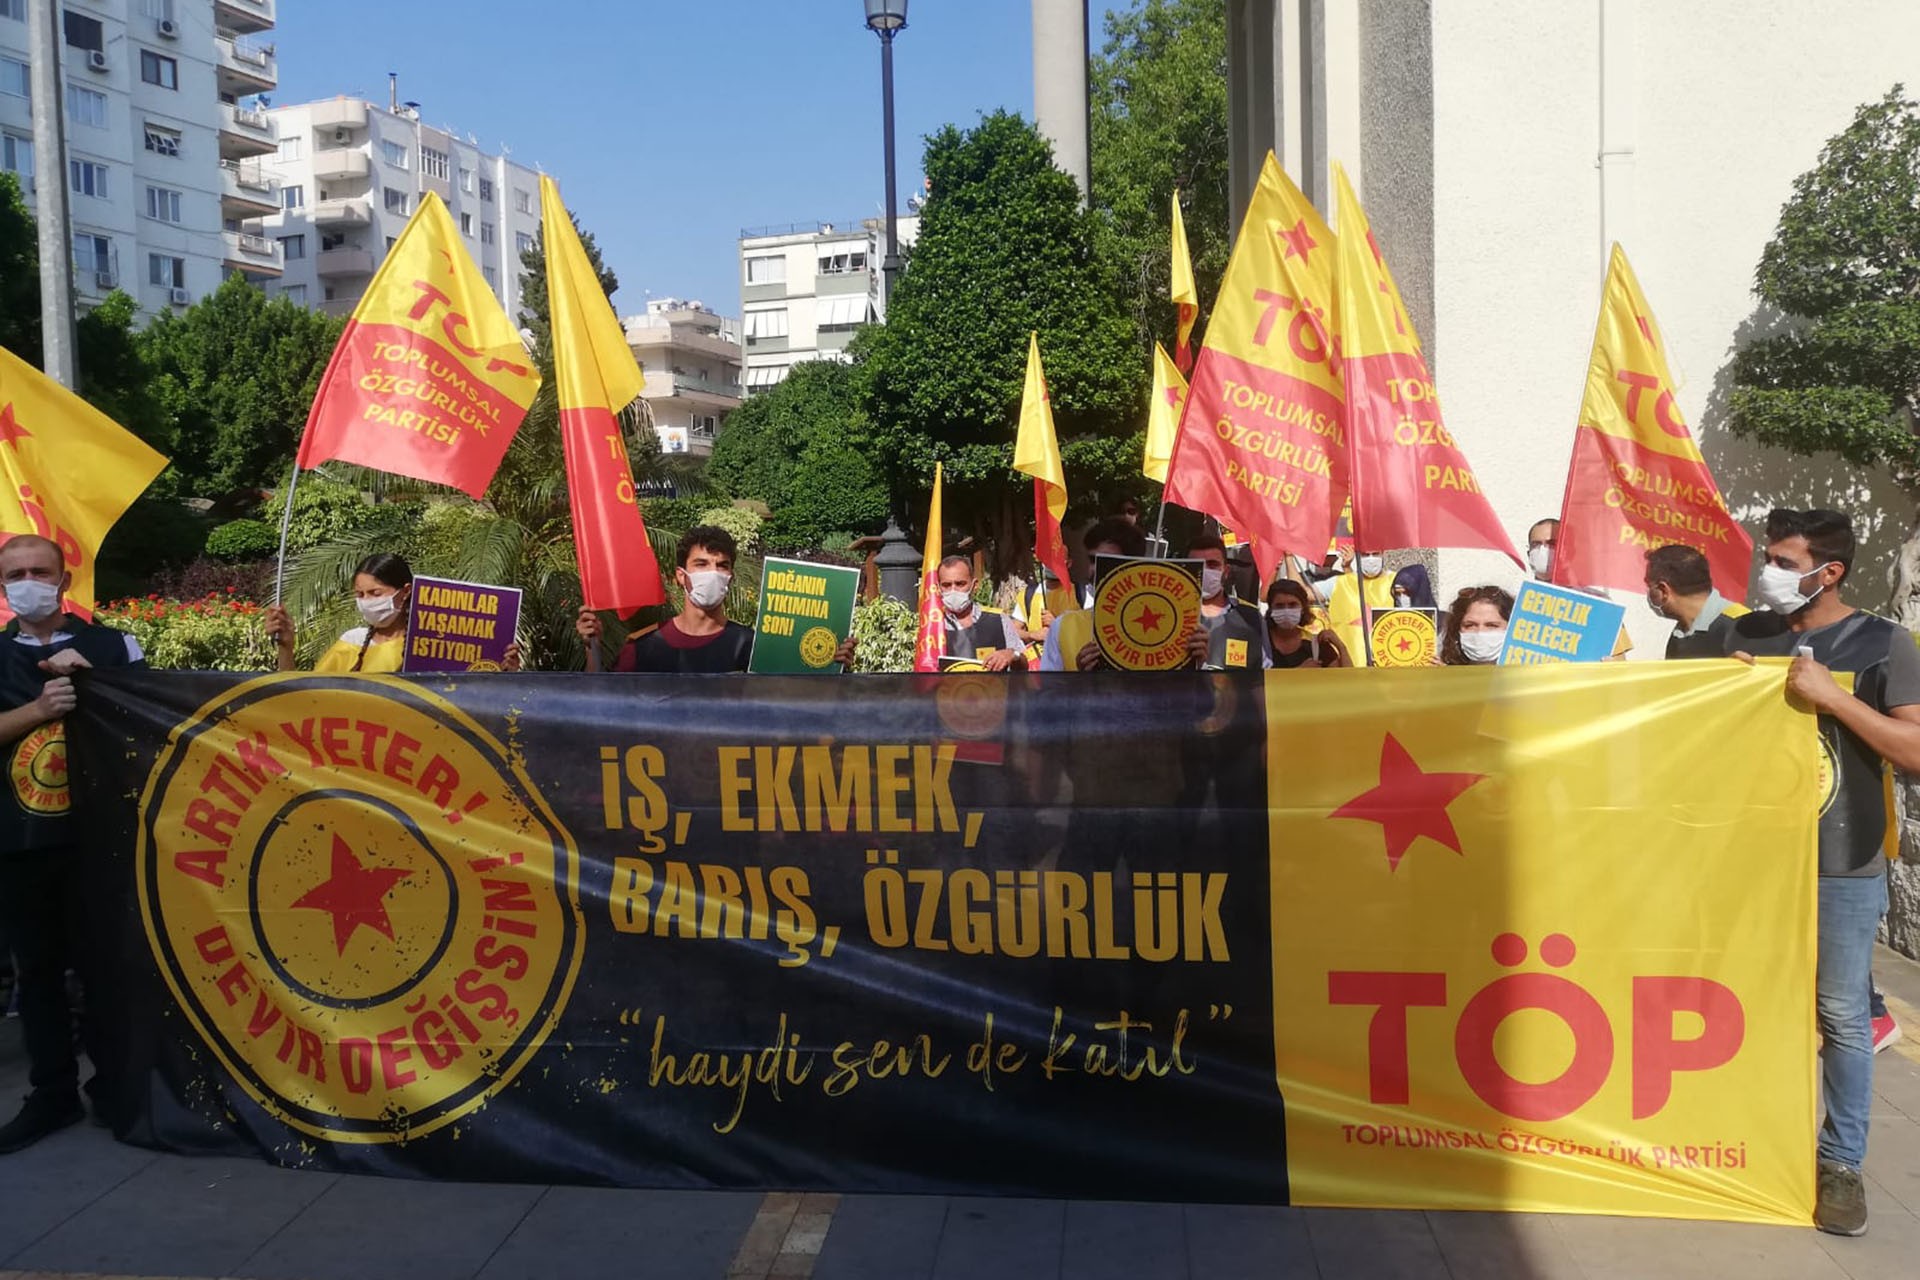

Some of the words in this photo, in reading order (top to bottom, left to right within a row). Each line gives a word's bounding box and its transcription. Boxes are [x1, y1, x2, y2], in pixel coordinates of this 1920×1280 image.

[359, 368, 491, 438] ÖZGÜRLÜK
[372, 341, 501, 424] TOPLUMSAL
[363, 403, 462, 446] PARTİSİ
[1222, 380, 1345, 448] TOPLUMSAL
[1216, 413, 1334, 480] ÖZGÜRLÜK
[1225, 459, 1306, 508] PARTİSİ
[1603, 483, 1730, 544] ÖZGÜRLÜK
[418, 585, 499, 615] KADINLAR
[766, 593, 829, 619] YIKIMINA
[767, 569, 827, 596] DOĞANIN
[1102, 575, 1136, 615] ARTIK
[1138, 571, 1190, 600] YETER!
[417, 610, 496, 640] YAŞAMAK
[761, 614, 795, 636] SON!
[1102, 624, 1141, 666] DEVİR
[1376, 619, 1396, 644] ARTIK
[1512, 618, 1582, 656] GELECEK
[17, 733, 45, 768] ARTIK
[174, 730, 287, 888] ARTIK
[280, 717, 489, 825] YETER!
[601, 744, 692, 853] İŞ,
[717, 745, 985, 848] EKMEK,
[608, 856, 842, 967] BARIŞ,
[862, 849, 1231, 963] ÖZGÜRLÜK
[193, 924, 327, 1084] DEVİR
[338, 852, 537, 1094] DEĞİŞSİN!
[1328, 932, 1746, 1122] TÖP
[822, 1034, 952, 1096] sen
[966, 1012, 1028, 1092] de
[1342, 1124, 1497, 1151] TOPLUMSAL
[1498, 1127, 1647, 1169] ÖZGÜRLÜK
[1653, 1141, 1747, 1170] PARTİSİ
